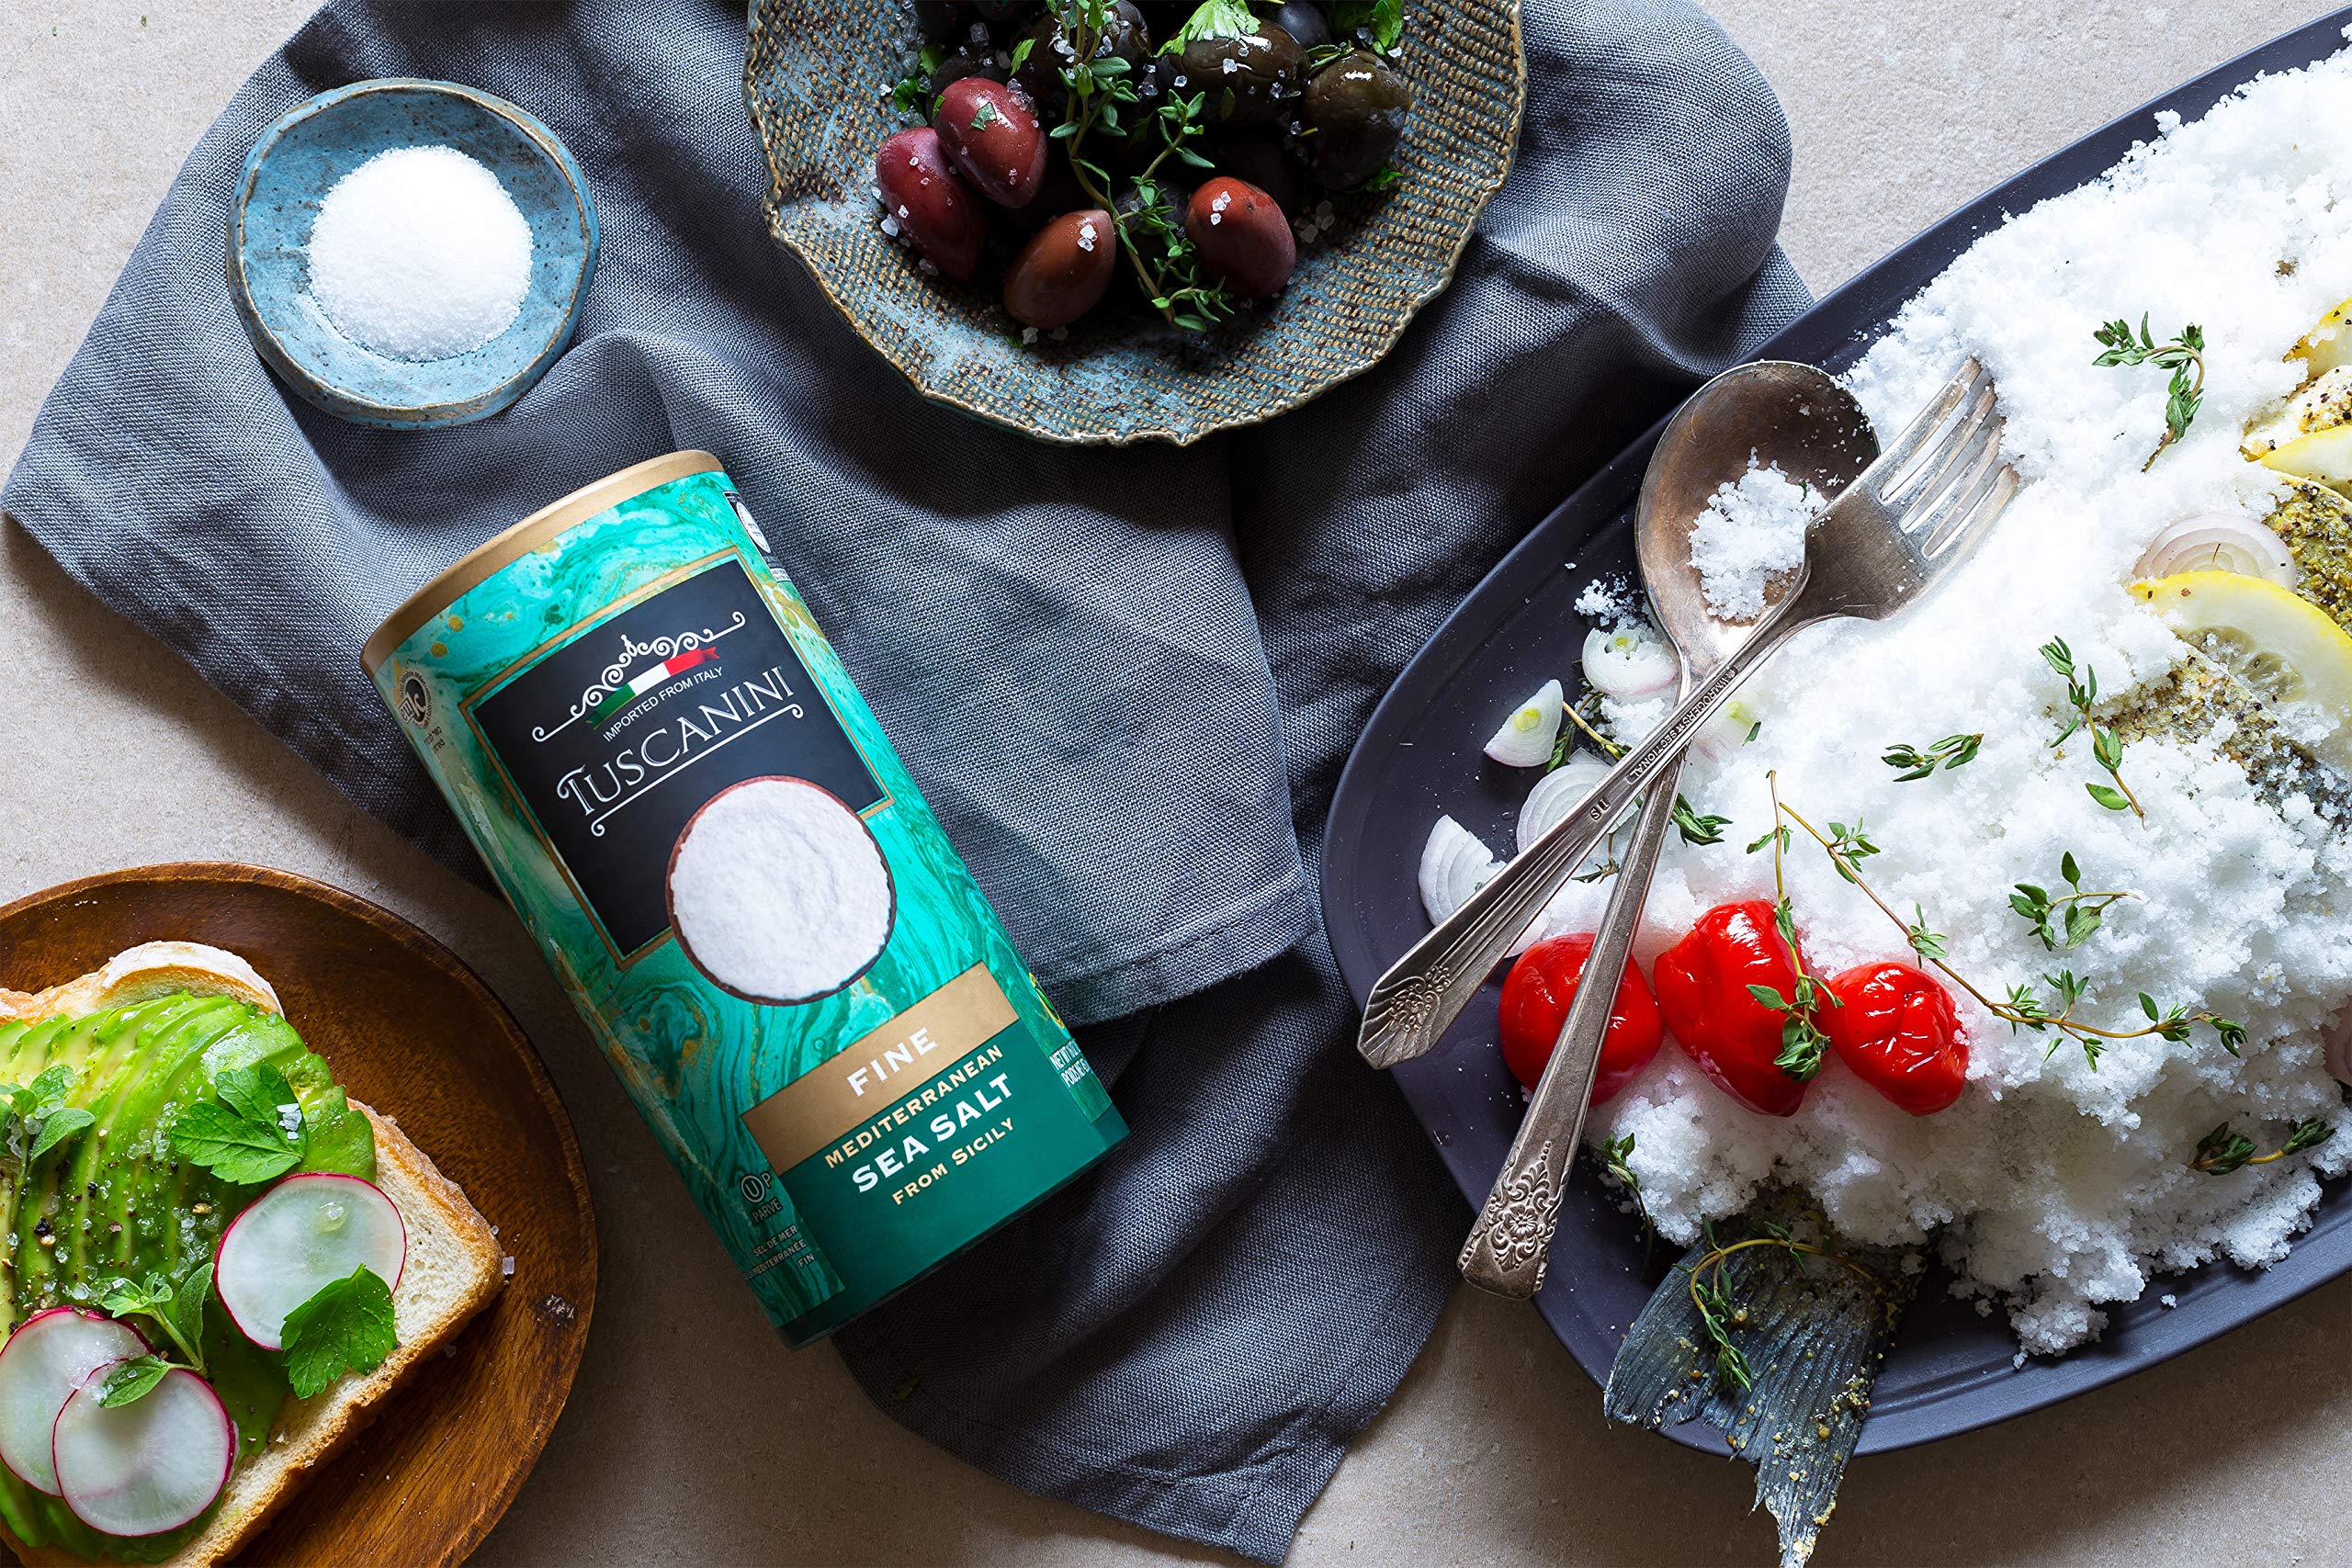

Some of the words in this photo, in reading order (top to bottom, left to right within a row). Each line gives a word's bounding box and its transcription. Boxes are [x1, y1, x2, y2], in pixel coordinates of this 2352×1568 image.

[603, 695, 659, 742] IMPORTED
[660, 677, 694, 703] FROM
[693, 666, 723, 685] ITALY
[557, 666, 795, 817] TUSCANINI
[1629, 730, 1678, 779] SECTIONAL
[847, 1027, 938, 1098] FINE
[824, 1044, 1003, 1169] MEDITERRANEAN
[852, 1135, 930, 1193] SEA
[930, 1072, 1012, 1143] SALT
[892, 1163, 948, 1205] FROM
[951, 1117, 1014, 1166] SICILY
[752, 1198, 782, 1224] PARVE
[753, 1246, 768, 1257] SEL
[767, 1236, 779, 1249] DE
[778, 1224, 798, 1242] MER
[797, 1252, 815, 1268] FIN
